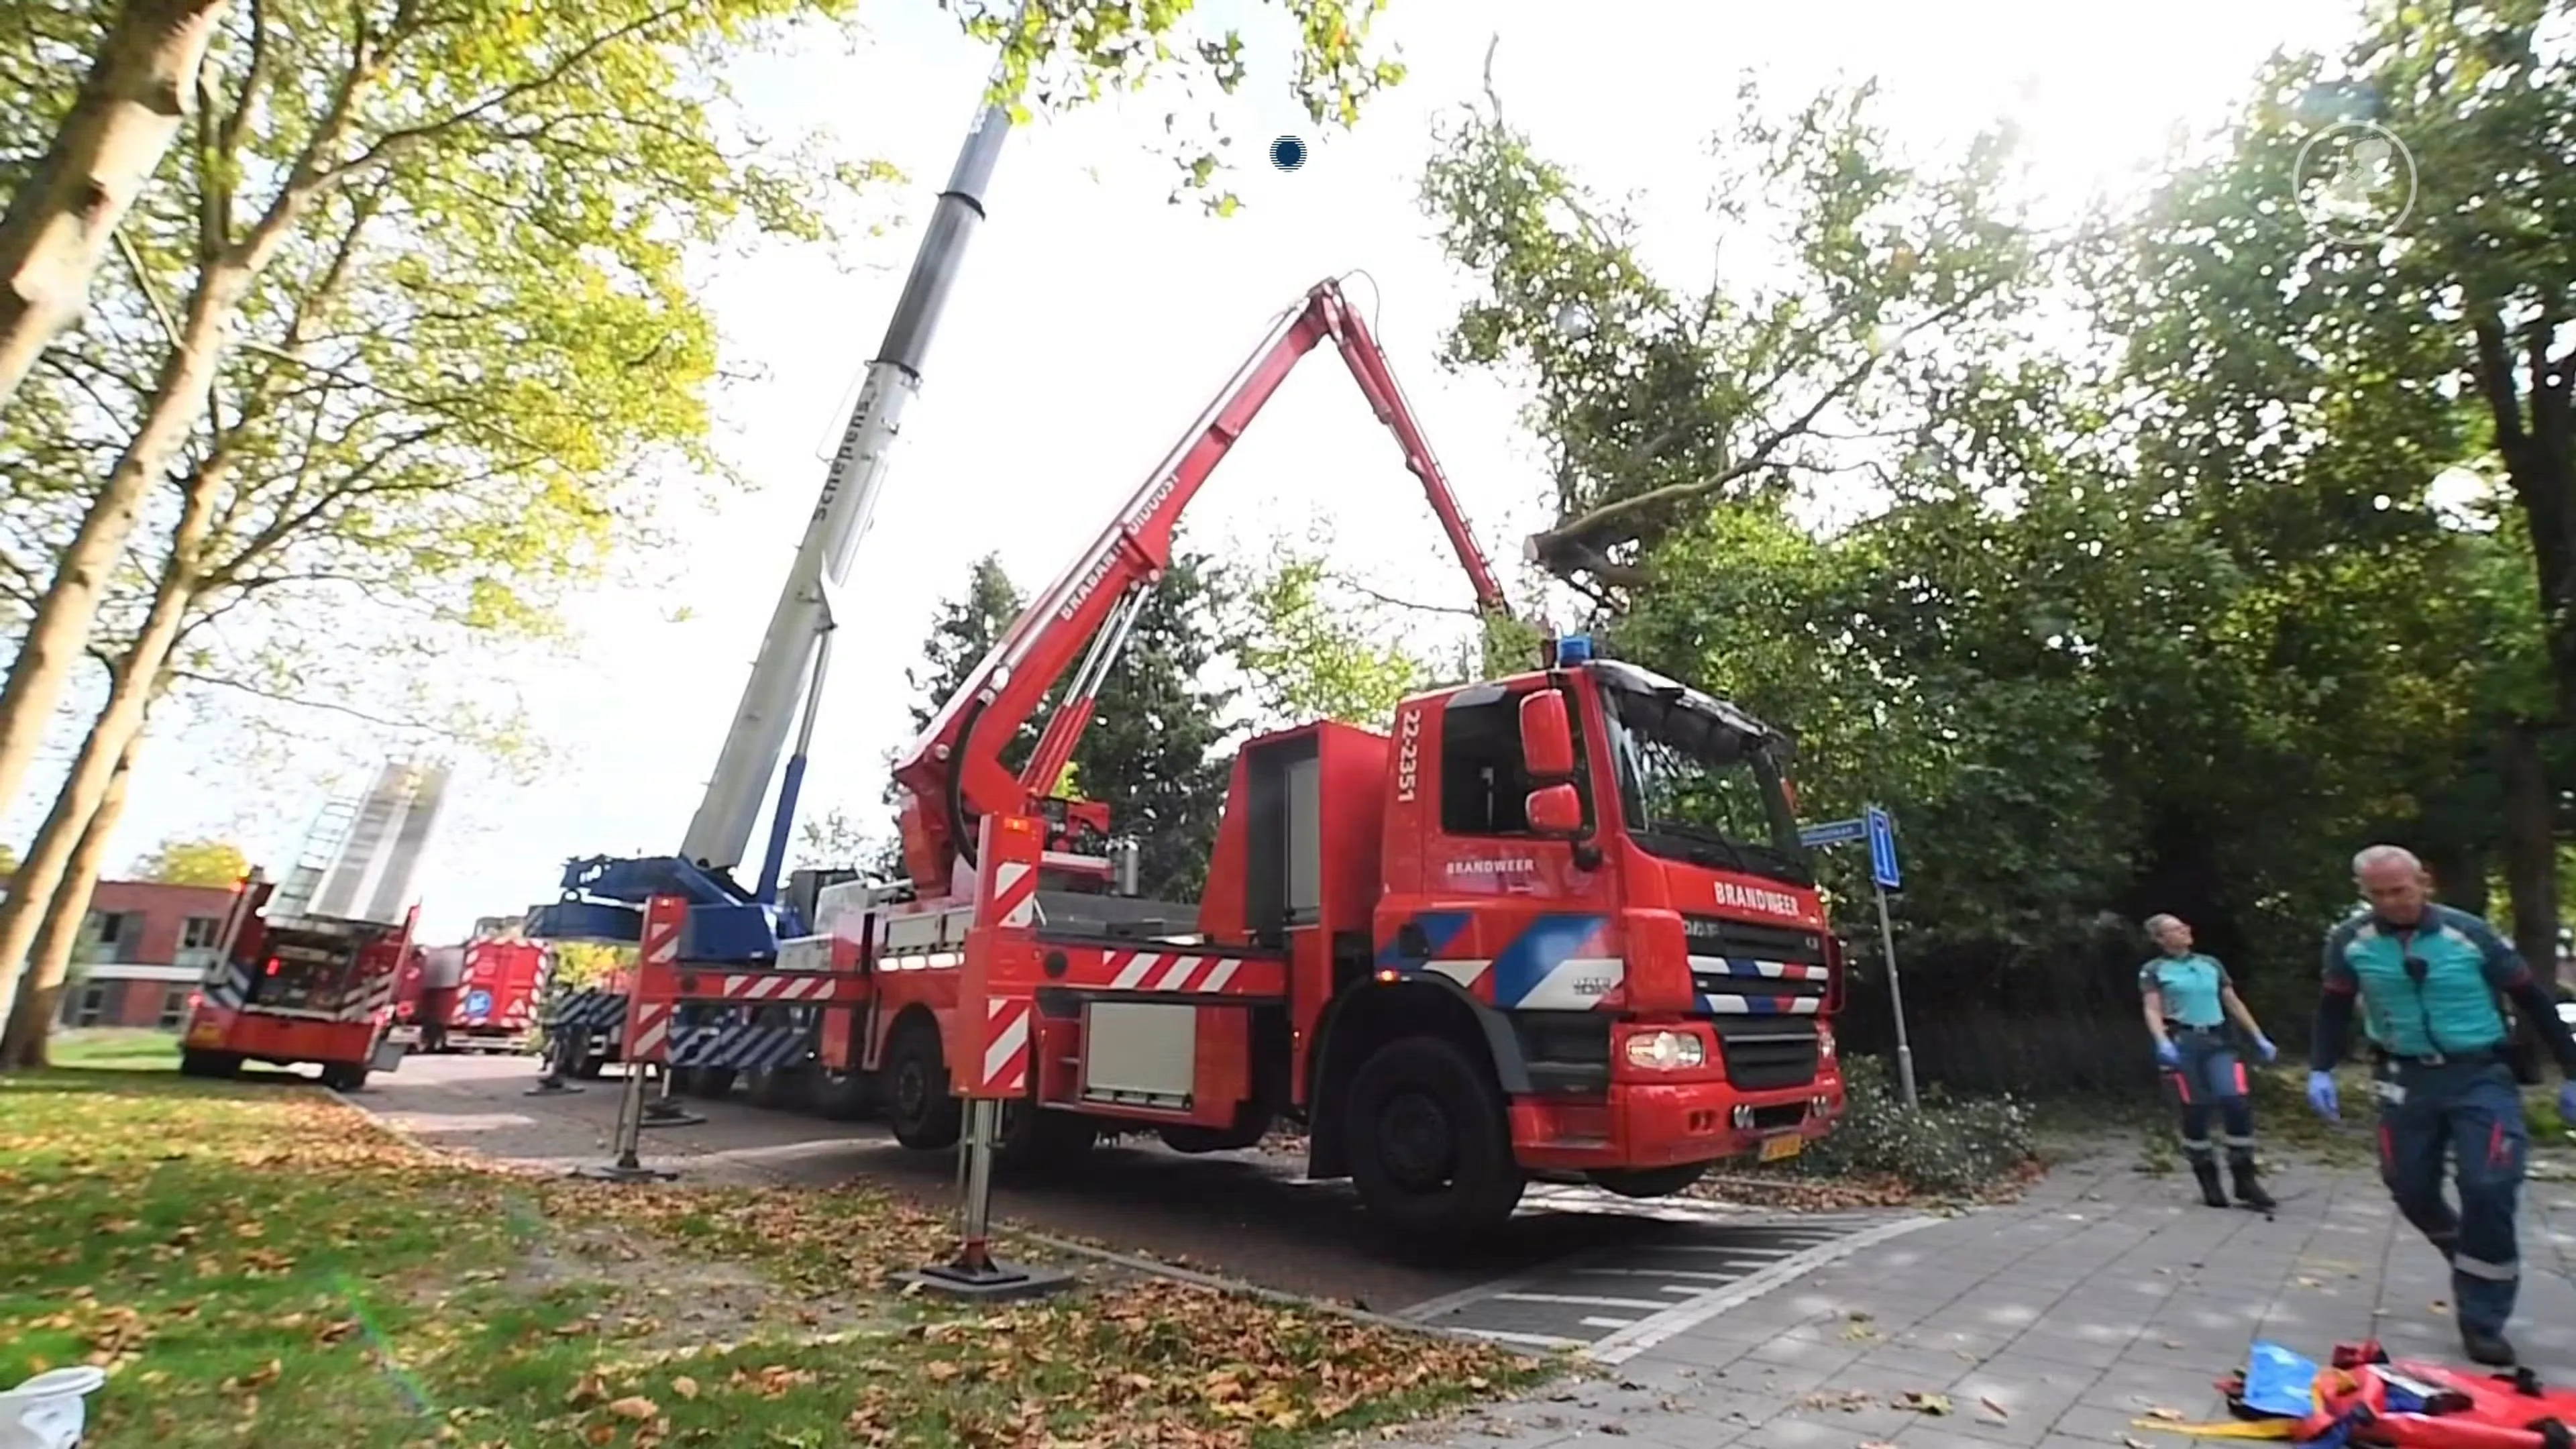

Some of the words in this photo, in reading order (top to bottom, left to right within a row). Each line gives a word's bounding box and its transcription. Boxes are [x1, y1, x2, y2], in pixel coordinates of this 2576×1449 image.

[1397, 709, 1421, 802] 22-2351
[1446, 858, 1534, 875] BRANDWEER
[1713, 881, 1801, 916] BRANDWEER
